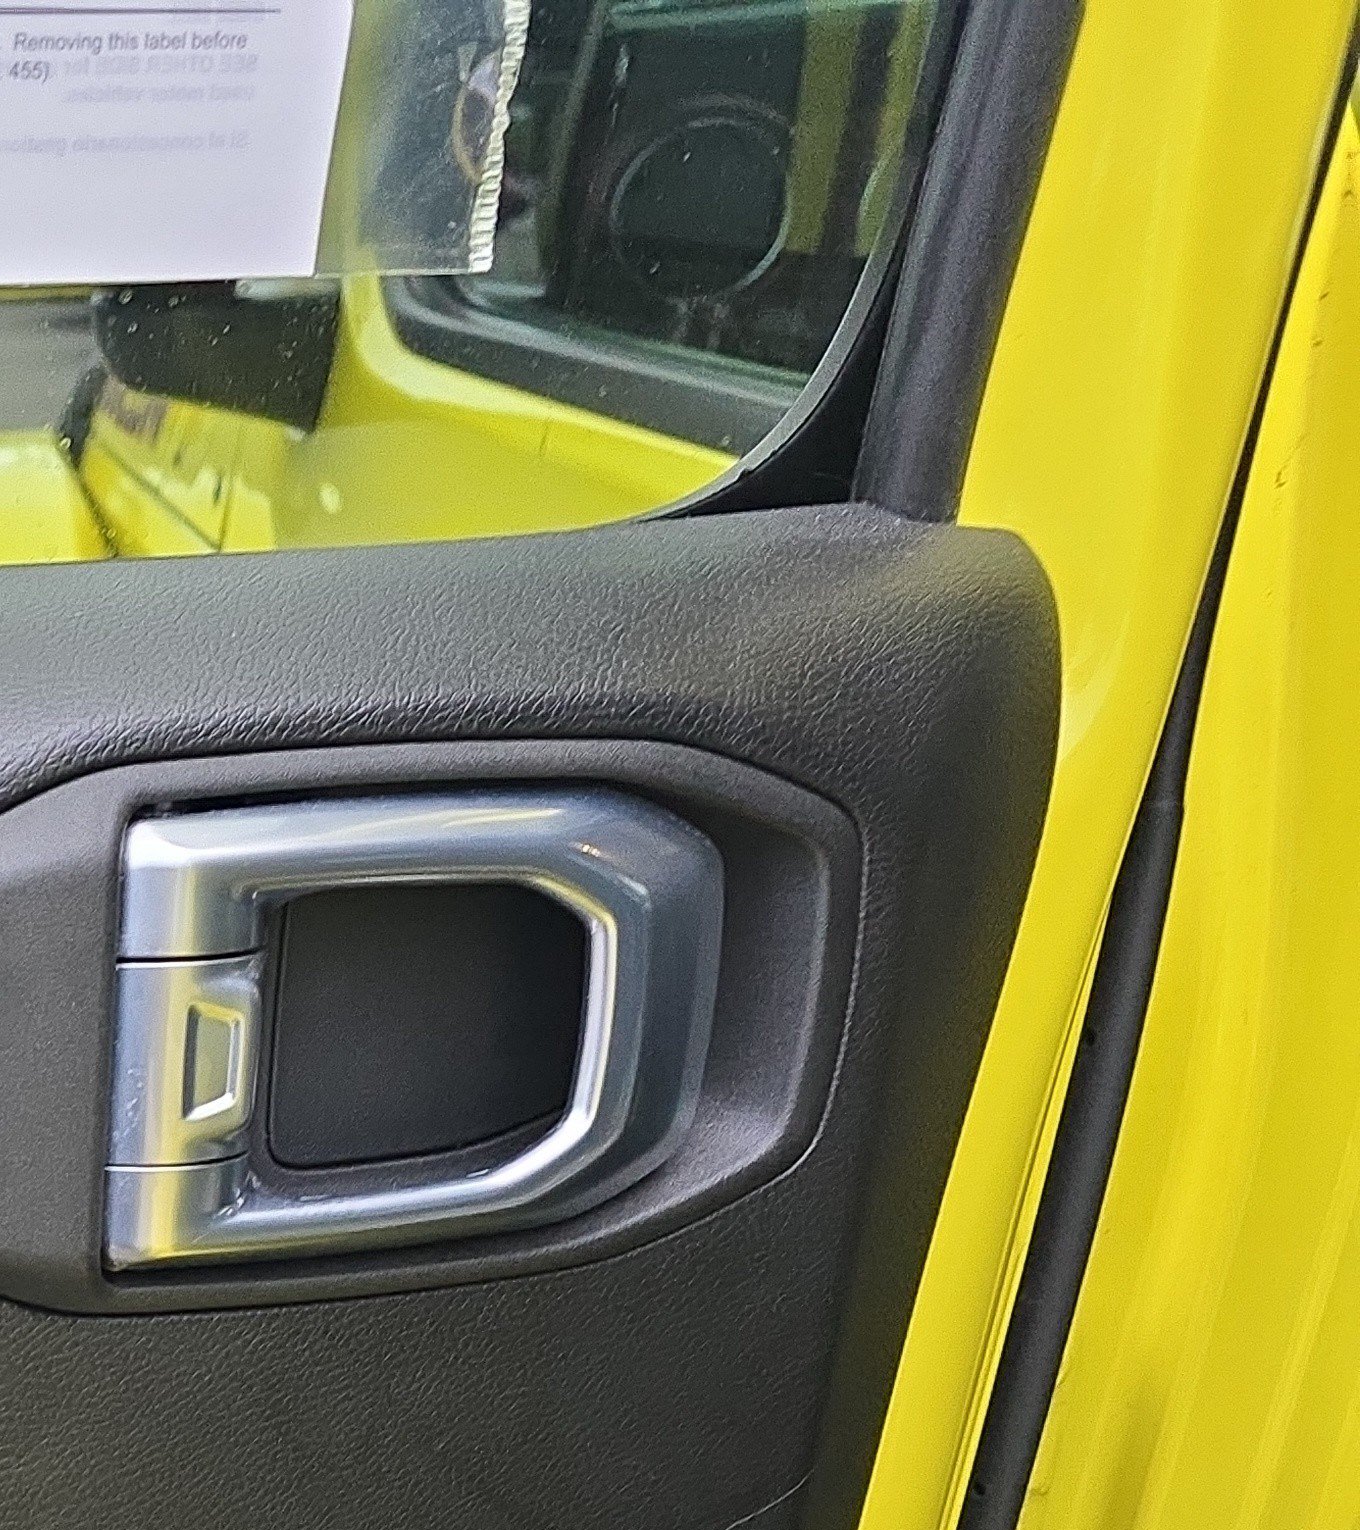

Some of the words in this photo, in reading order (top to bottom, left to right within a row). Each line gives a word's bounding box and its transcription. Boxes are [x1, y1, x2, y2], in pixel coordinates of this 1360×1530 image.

[13, 31, 102, 55] Removing
[108, 31, 138, 50] this
[144, 31, 186, 50] label
[191, 31, 247, 50] before
